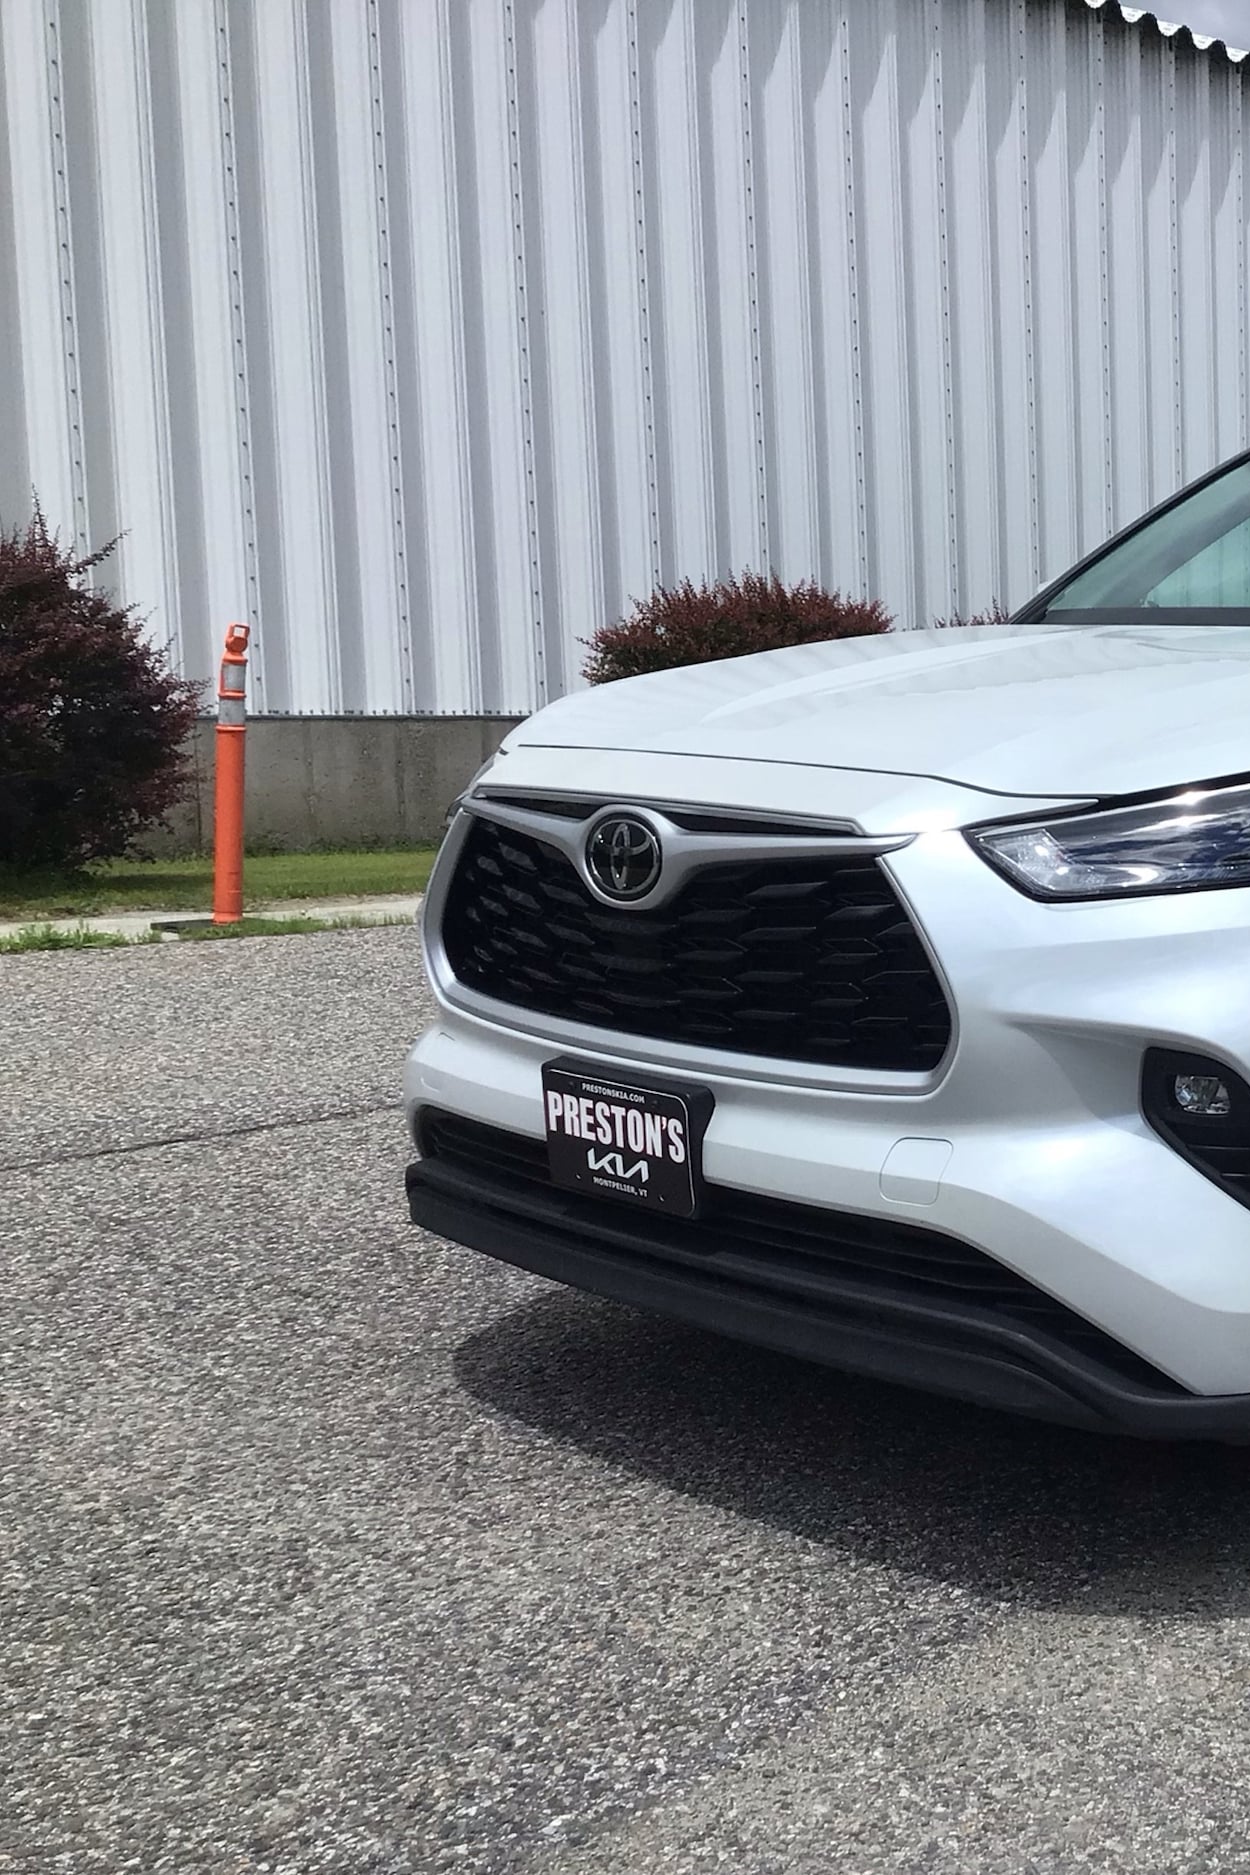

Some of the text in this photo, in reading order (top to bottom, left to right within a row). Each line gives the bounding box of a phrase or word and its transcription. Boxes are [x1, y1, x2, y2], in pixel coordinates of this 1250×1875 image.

[582, 1083, 645, 1103] PRESTONSKIA.COM
[547, 1090, 686, 1163] PRESTON'S
[593, 1176, 648, 1197] MONTPELIER, VT
